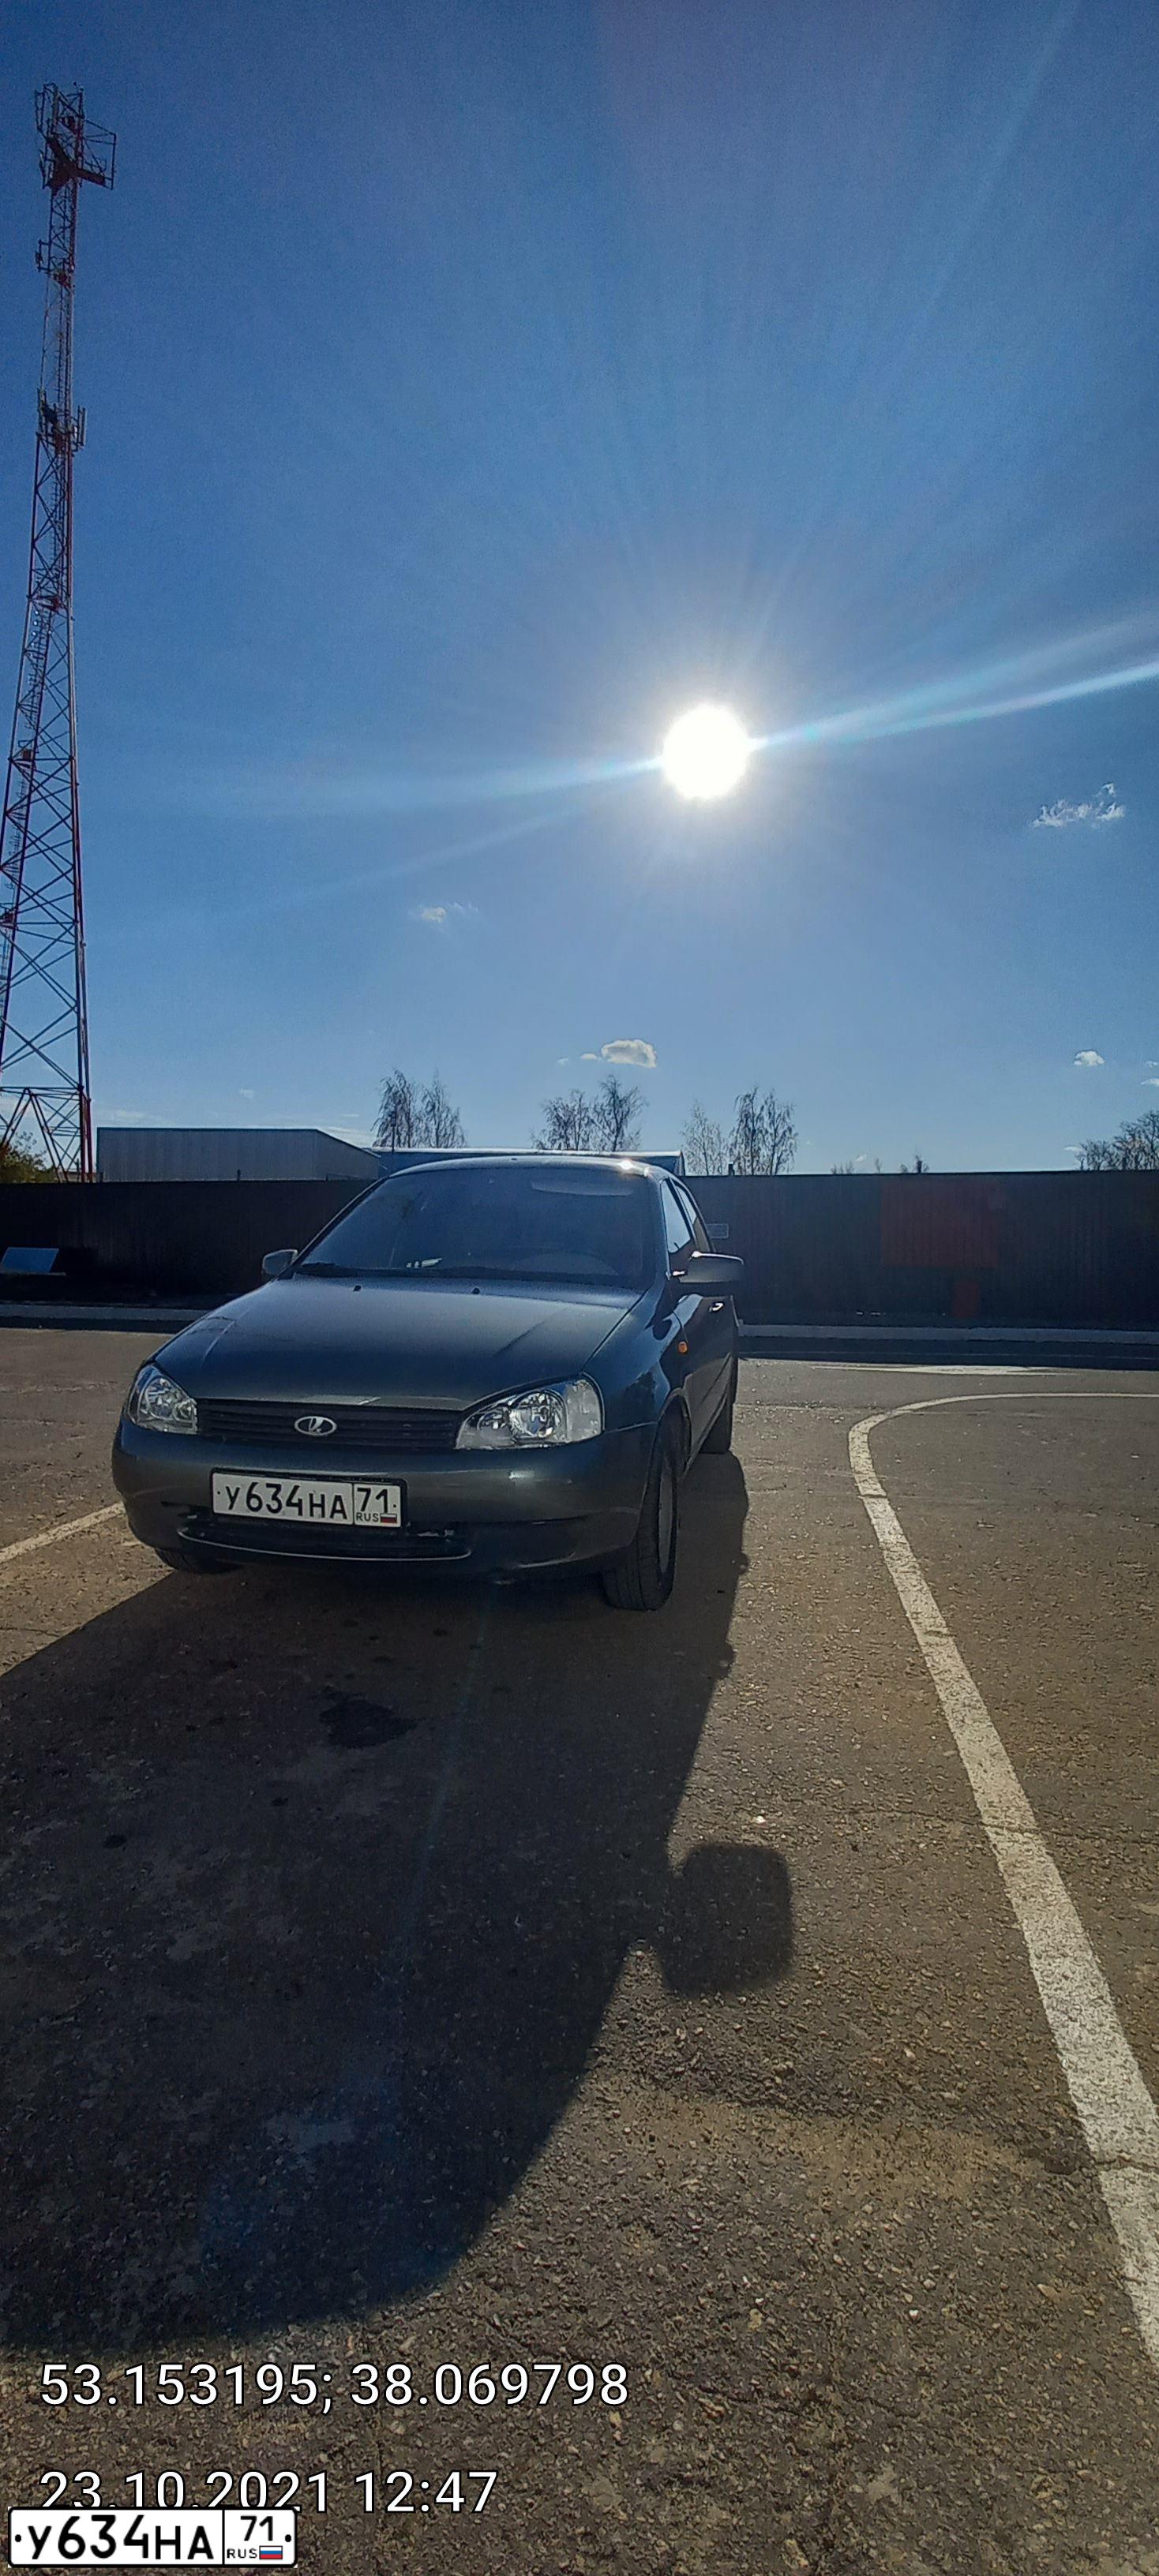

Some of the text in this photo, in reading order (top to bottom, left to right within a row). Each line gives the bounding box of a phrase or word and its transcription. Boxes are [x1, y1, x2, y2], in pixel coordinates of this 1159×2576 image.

[224, 1481, 388, 1520] У634НА 71
[356, 1512, 379, 1522] RUS
